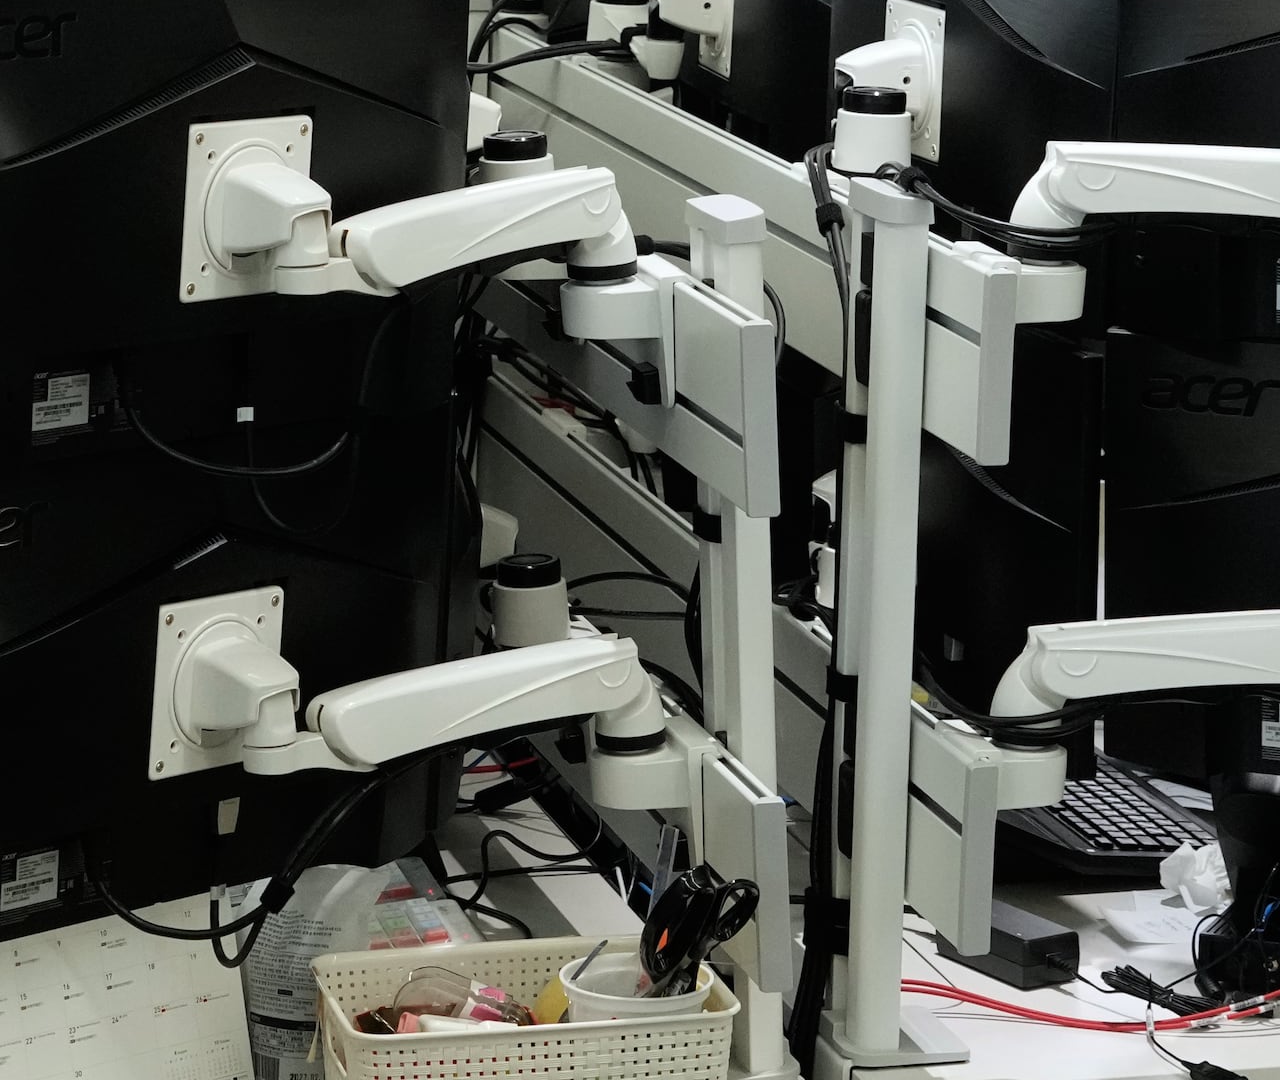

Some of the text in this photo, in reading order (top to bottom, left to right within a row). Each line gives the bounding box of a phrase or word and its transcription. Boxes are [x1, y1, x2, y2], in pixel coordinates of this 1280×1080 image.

[2, 852, 17, 862] acer
[184, 910, 191, 918] 12
[20, 993, 27, 1001] 15
[154, 1006, 161, 1014] 25
[112, 1016, 119, 1024] 24
[25, 1037, 33, 1045] 22
[75, 1070, 82, 1078] 30
